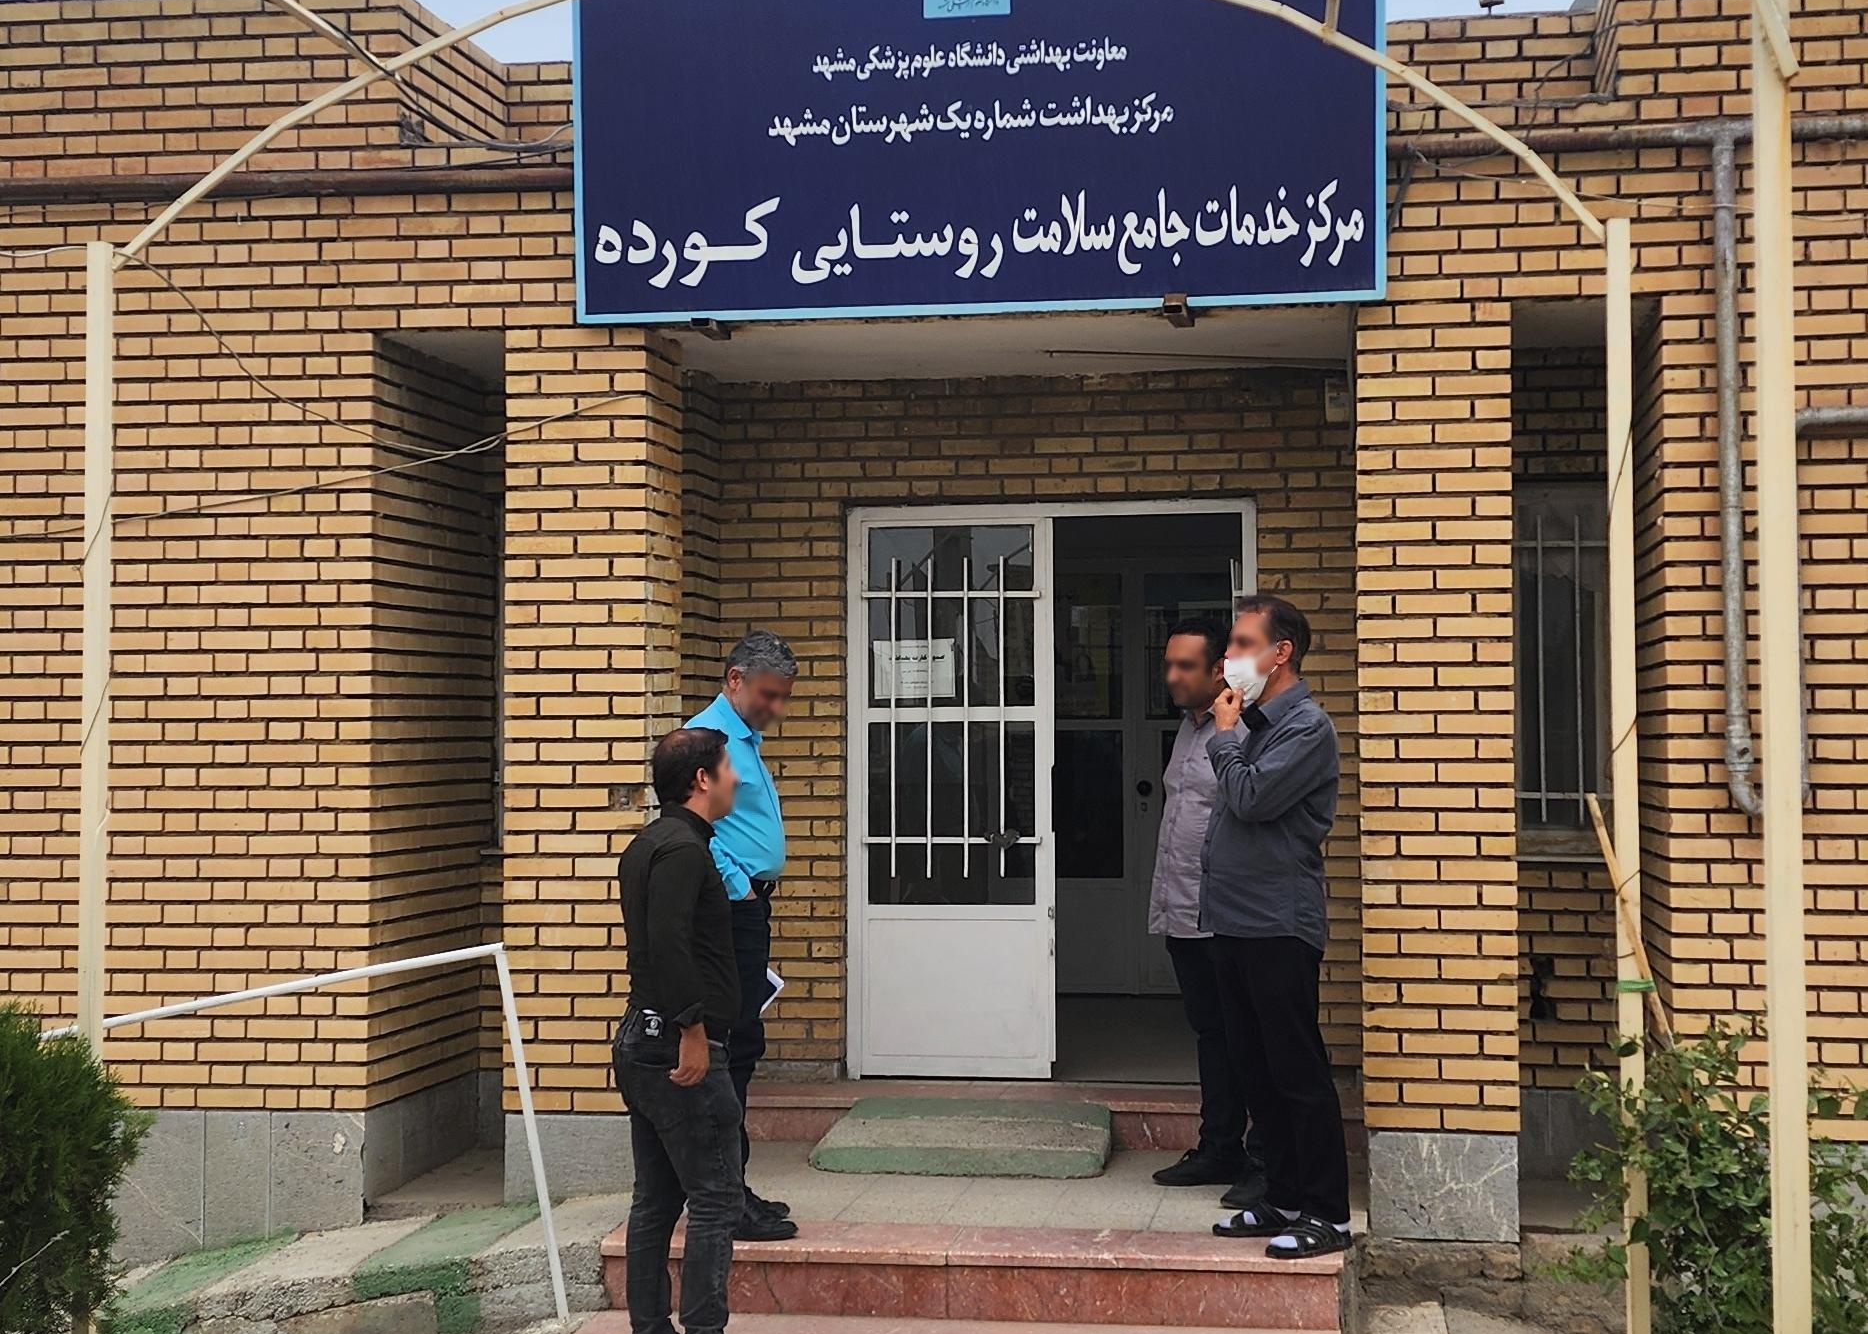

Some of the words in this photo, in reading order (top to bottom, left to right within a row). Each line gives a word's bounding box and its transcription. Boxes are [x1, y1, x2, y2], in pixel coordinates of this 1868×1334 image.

[812, 47, 857, 81] مشهد
[856, 45, 910, 80] پزشکی
[911, 43, 946, 78] علوم
[948, 41, 1006, 68] دانشگاه
[1006, 39, 1071, 74] بهداشتی
[1073, 36, 1127, 70] معاونت
[768, 108, 831, 147] مشهد
[831, 103, 934, 145] شهرستان
[936, 100, 972, 139] یک
[974, 99, 1036, 141] شماره
[1039, 96, 1129, 135] بهداشت
[1129, 92, 1175, 134] مرکز
[1012, 188, 1116, 256] سلامت
[1117, 186, 1191, 275] جامع
[1195, 184, 1300, 247] خدمات
[1300, 178, 1364, 268] مرکز
[594, 196, 781, 289] کورده
[791, 202, 1004, 285] روستایی
